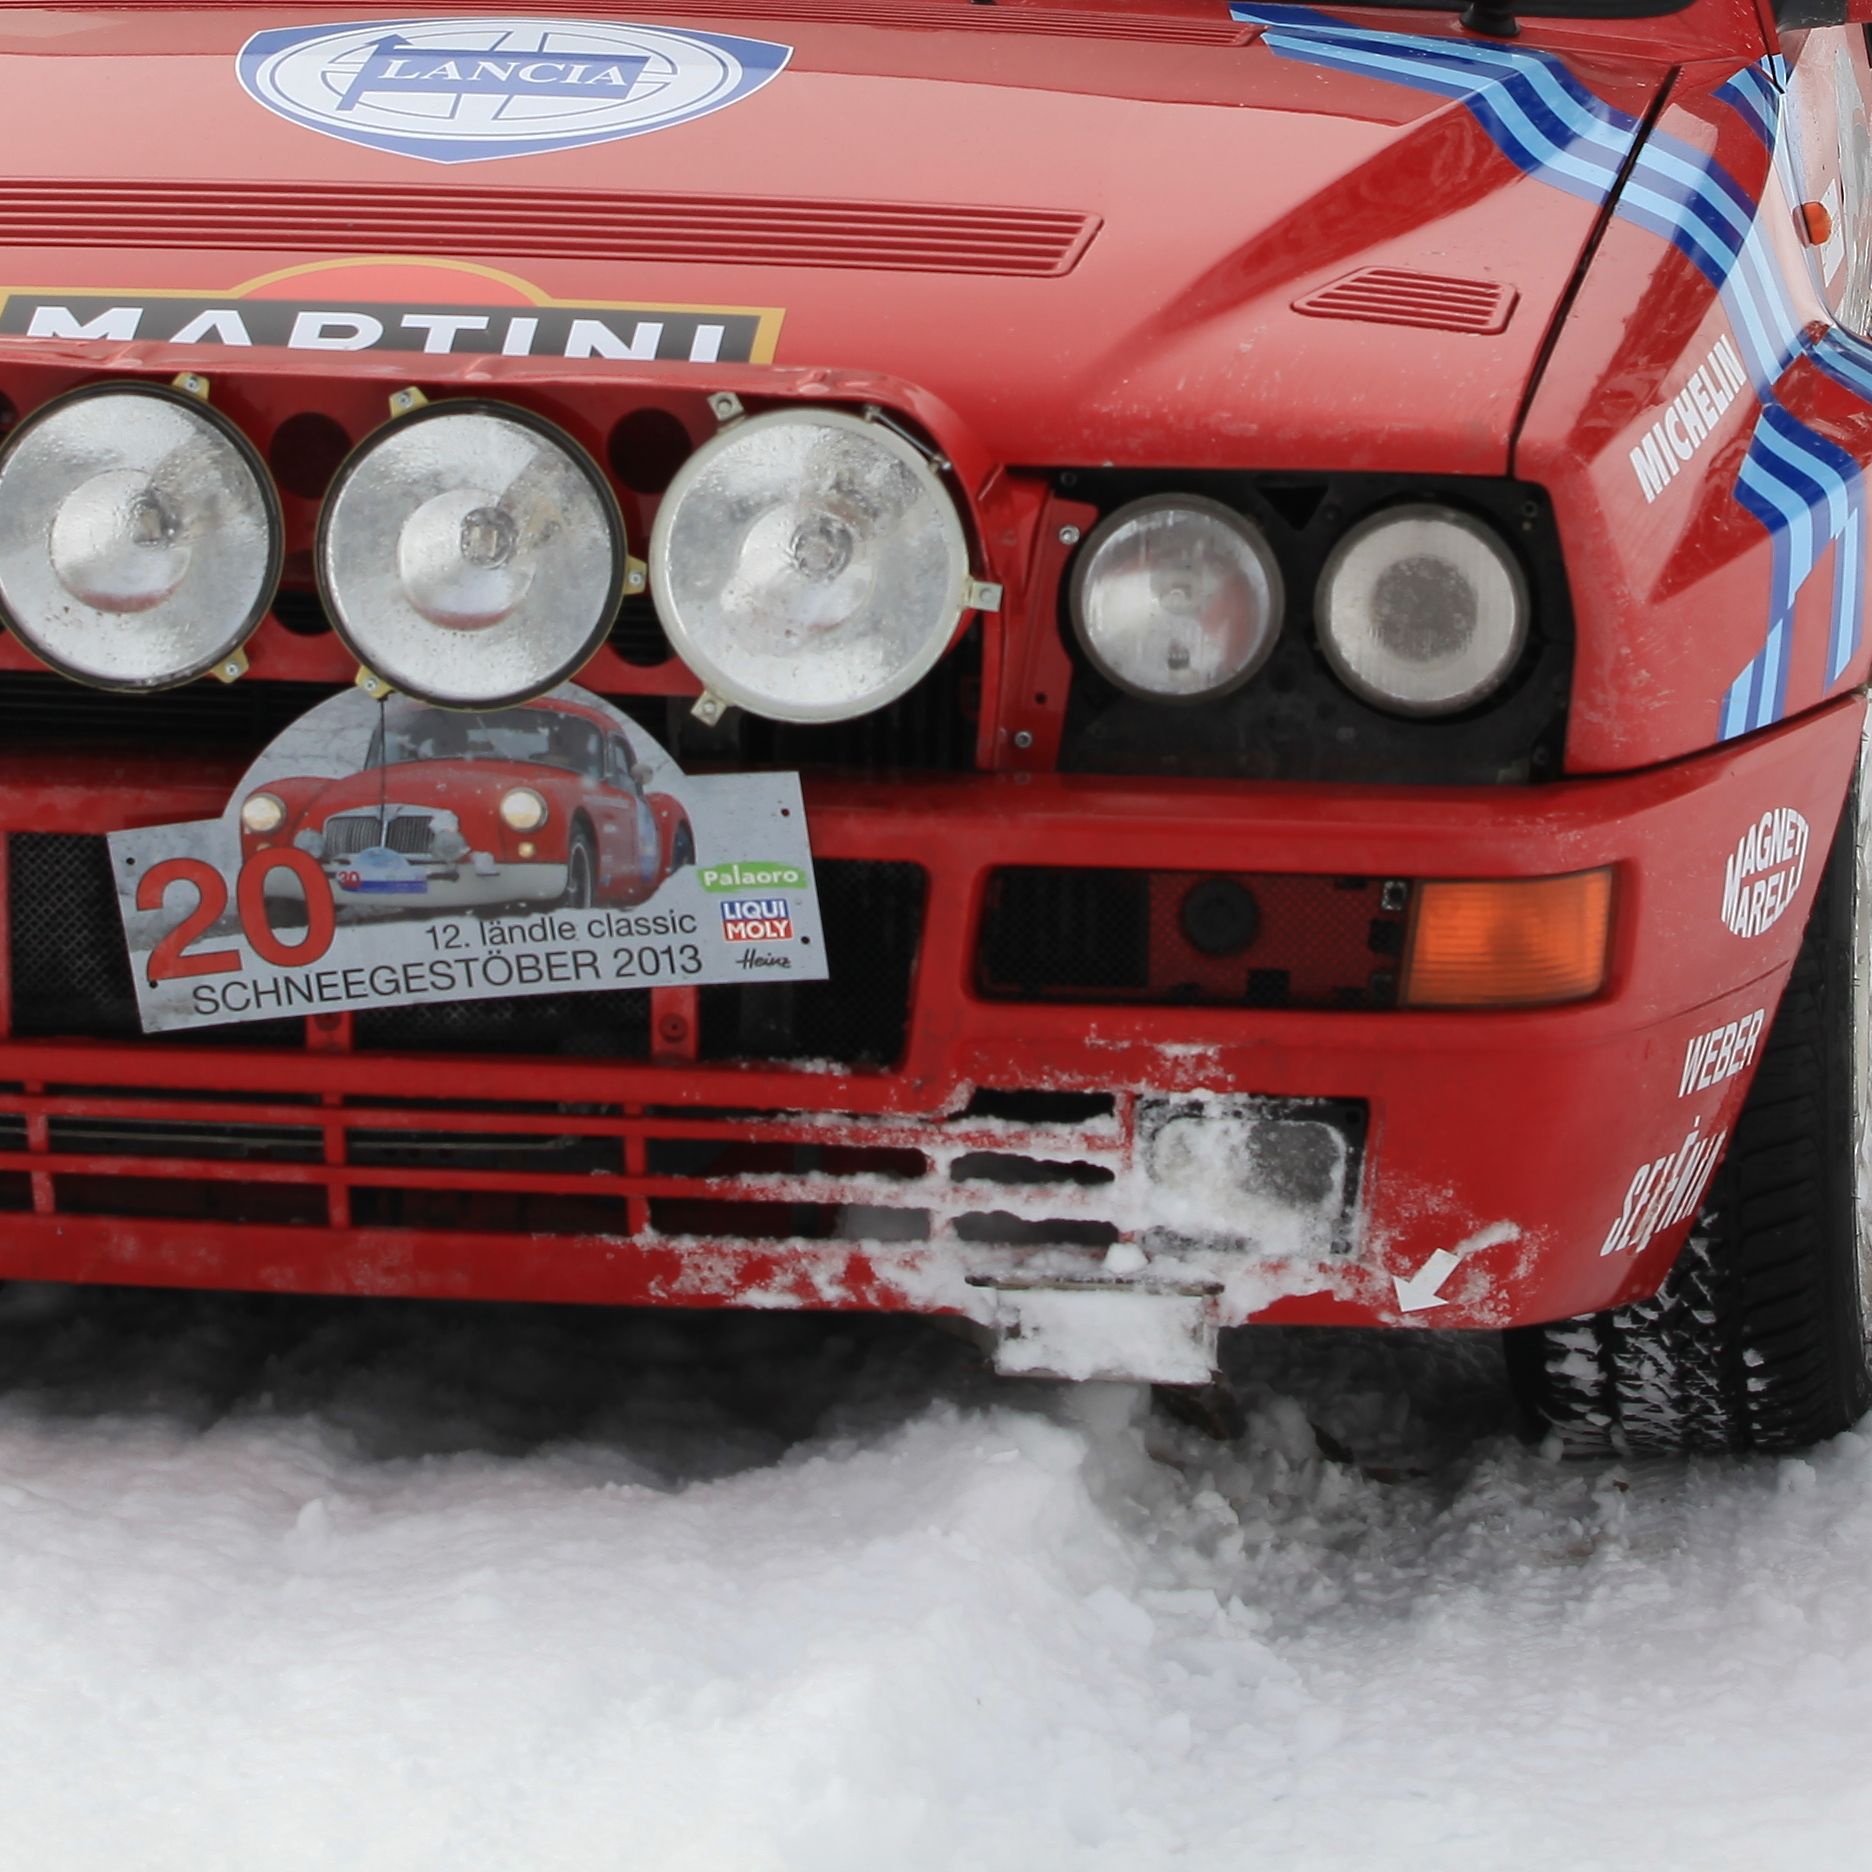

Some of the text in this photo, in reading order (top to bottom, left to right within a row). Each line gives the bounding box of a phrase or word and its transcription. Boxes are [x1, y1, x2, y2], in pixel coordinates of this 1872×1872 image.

[378, 59, 628, 85] LANCIA
[1629, 333, 1747, 504] MICHELIN
[703, 864, 799, 887] Palaoro
[1723, 807, 1809, 893] MAGNETI
[135, 847, 336, 982] 20
[723, 900, 787, 921] LIQUI
[1721, 860, 1805, 938] MARELLI
[426, 909, 698, 951] 12. ländle classic
[726, 920, 788, 940] MOLY
[736, 948, 792, 969] Heinz
[192, 943, 703, 1015] SCHNEEGESTÖBER 2013
[1678, 1008, 1765, 1098] WEBER
